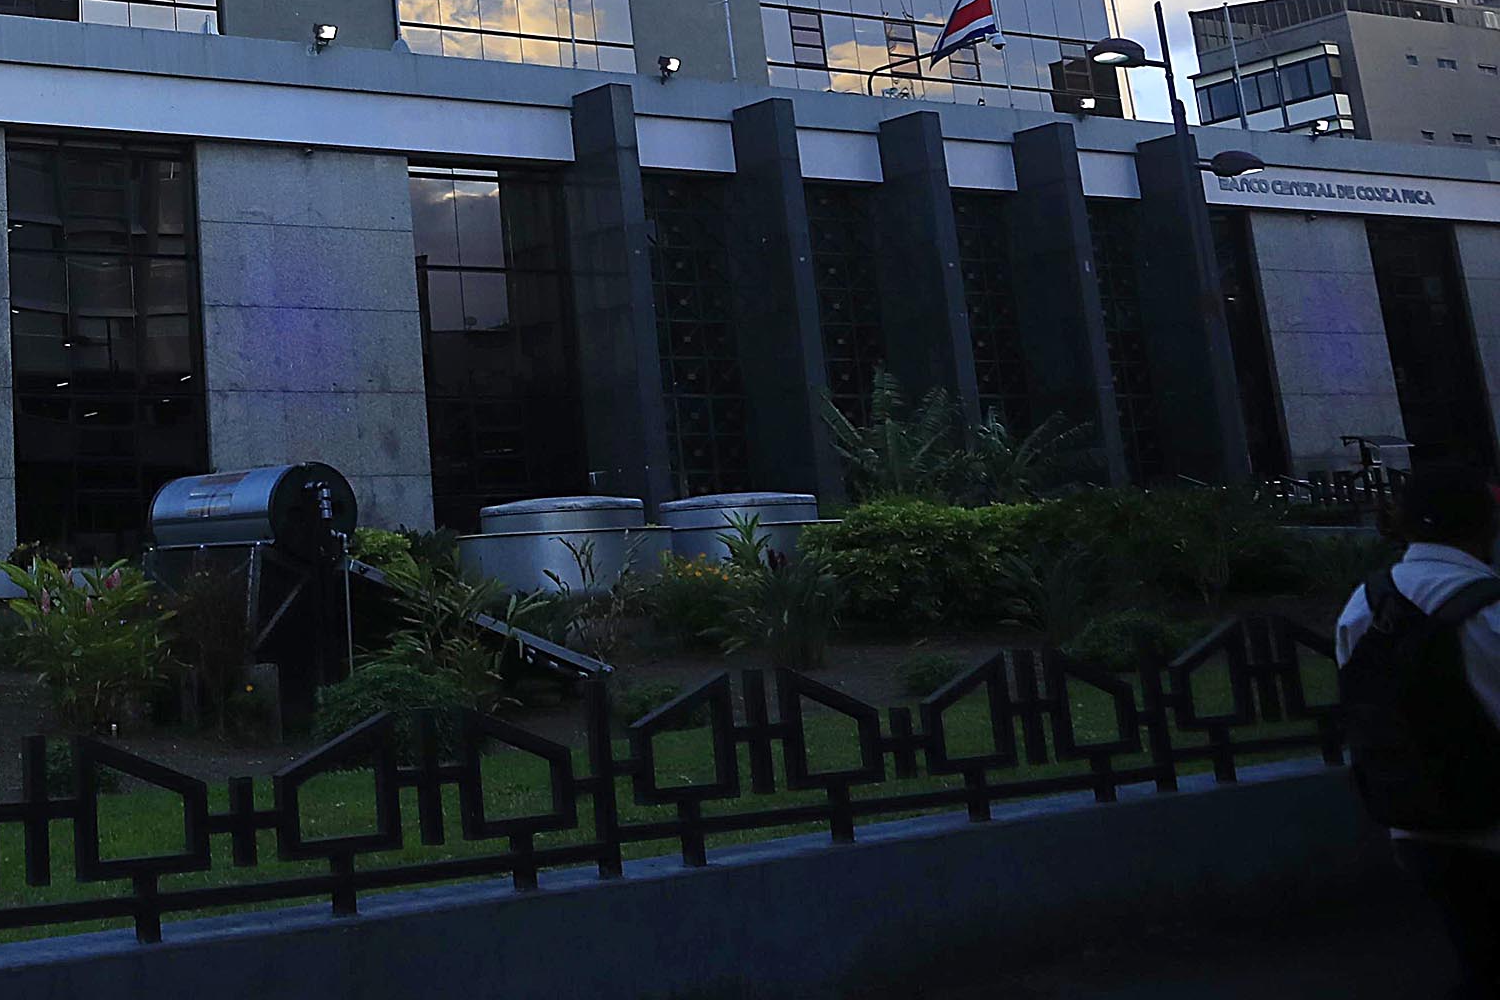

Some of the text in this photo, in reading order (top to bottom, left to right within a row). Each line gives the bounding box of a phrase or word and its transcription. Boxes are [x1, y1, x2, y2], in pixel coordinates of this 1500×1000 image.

[1219, 177, 1435, 205] BANCO CENTRAL DE COSTA RICA
